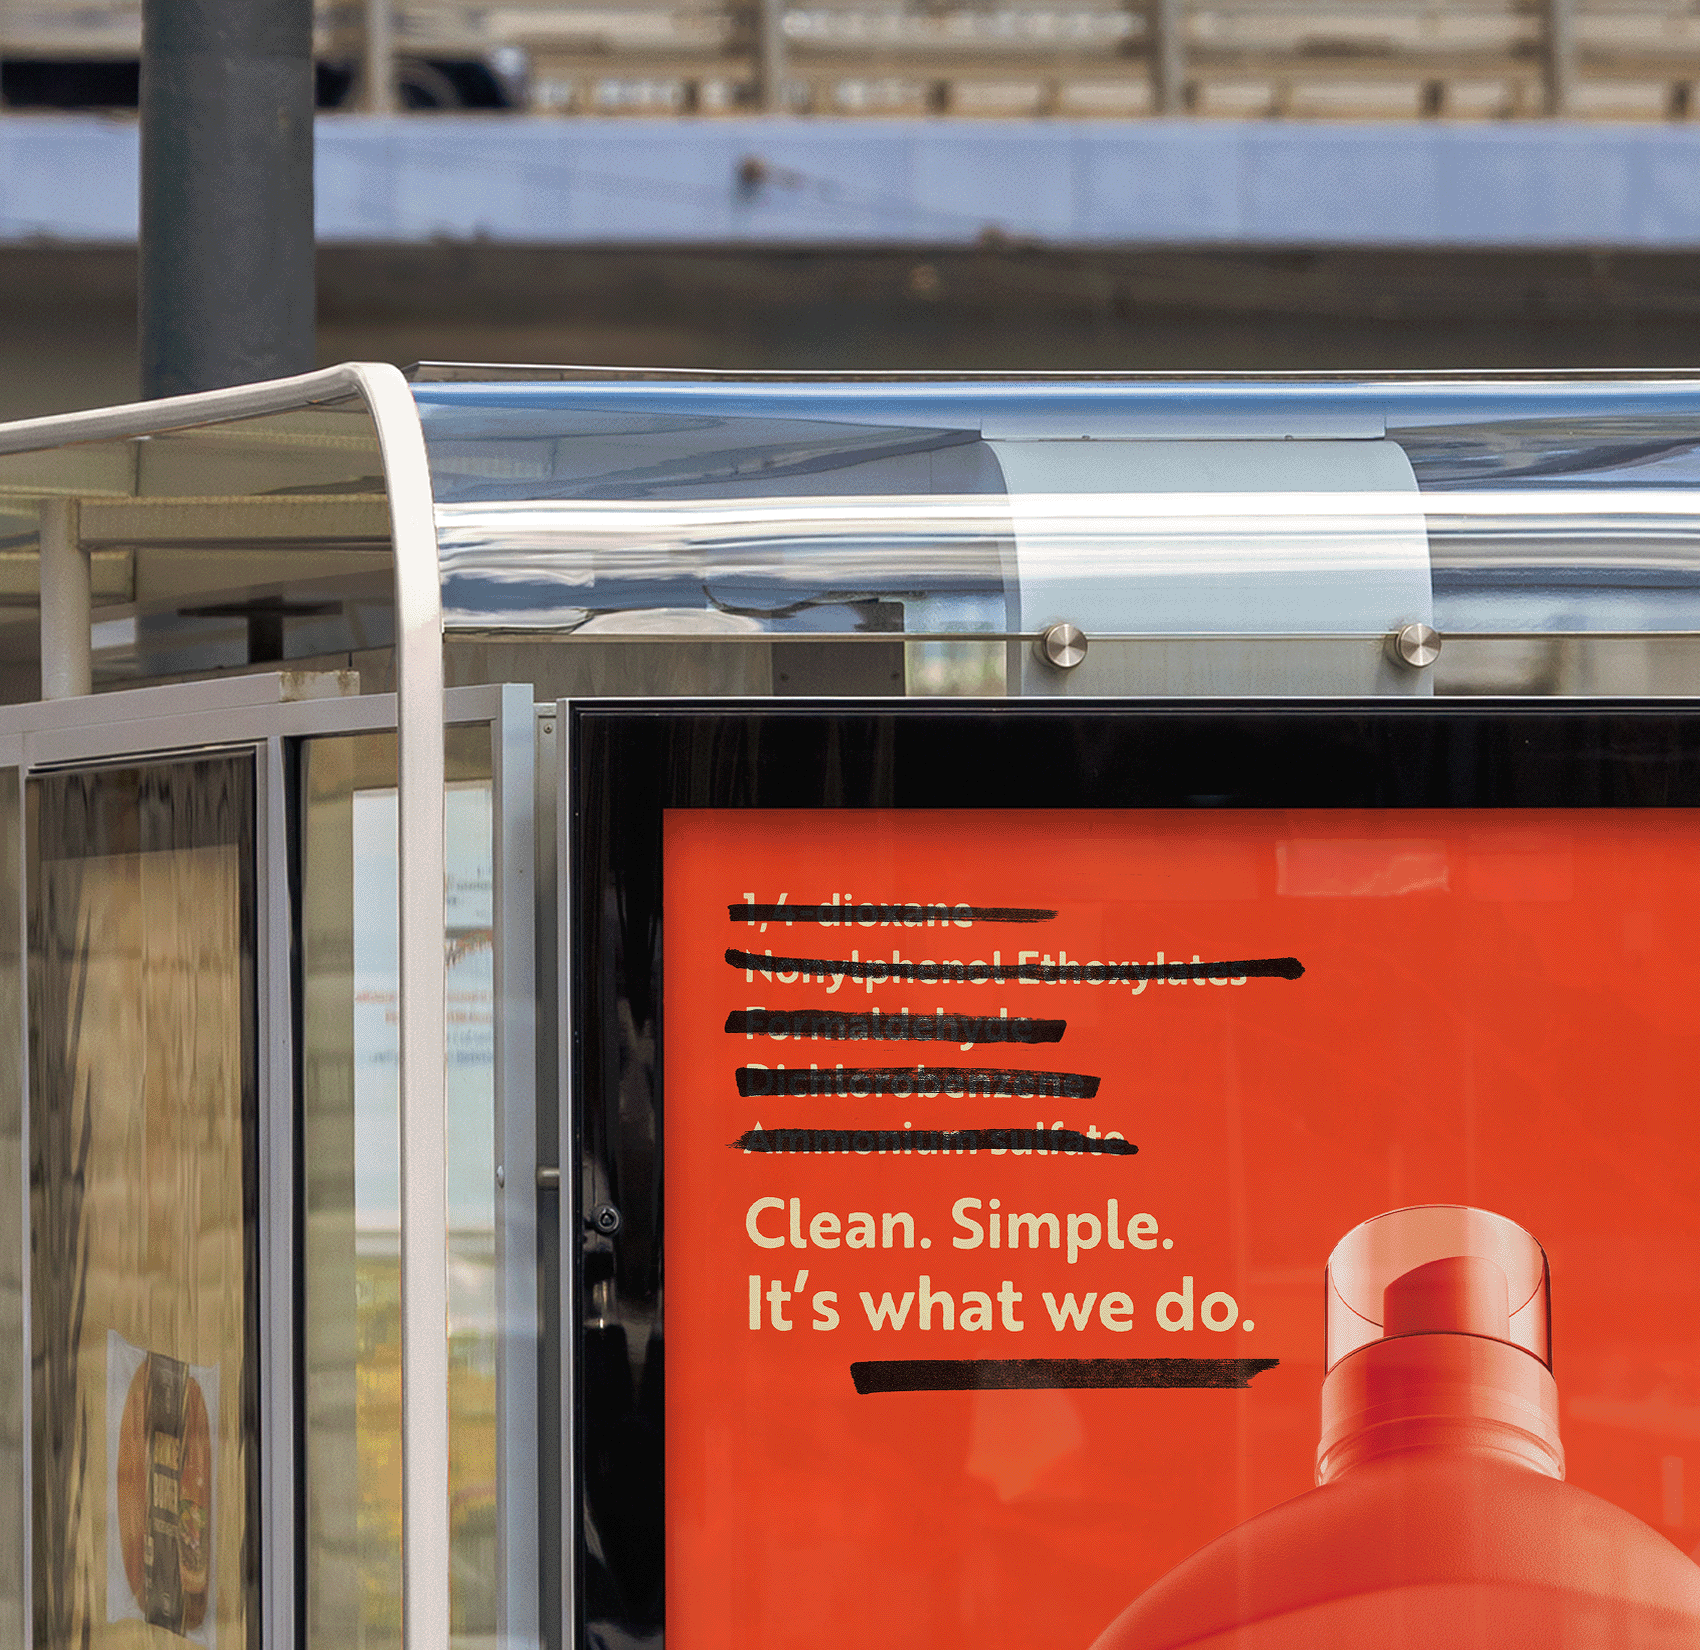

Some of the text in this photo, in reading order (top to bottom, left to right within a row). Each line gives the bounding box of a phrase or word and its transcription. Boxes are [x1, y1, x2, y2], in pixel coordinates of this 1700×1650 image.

[746, 949, 1247, 995] Nonylphenol Ethoxylates
[744, 1197, 1174, 1264] Clean. Simple.
[749, 1270, 1256, 1332] It's what we do.
